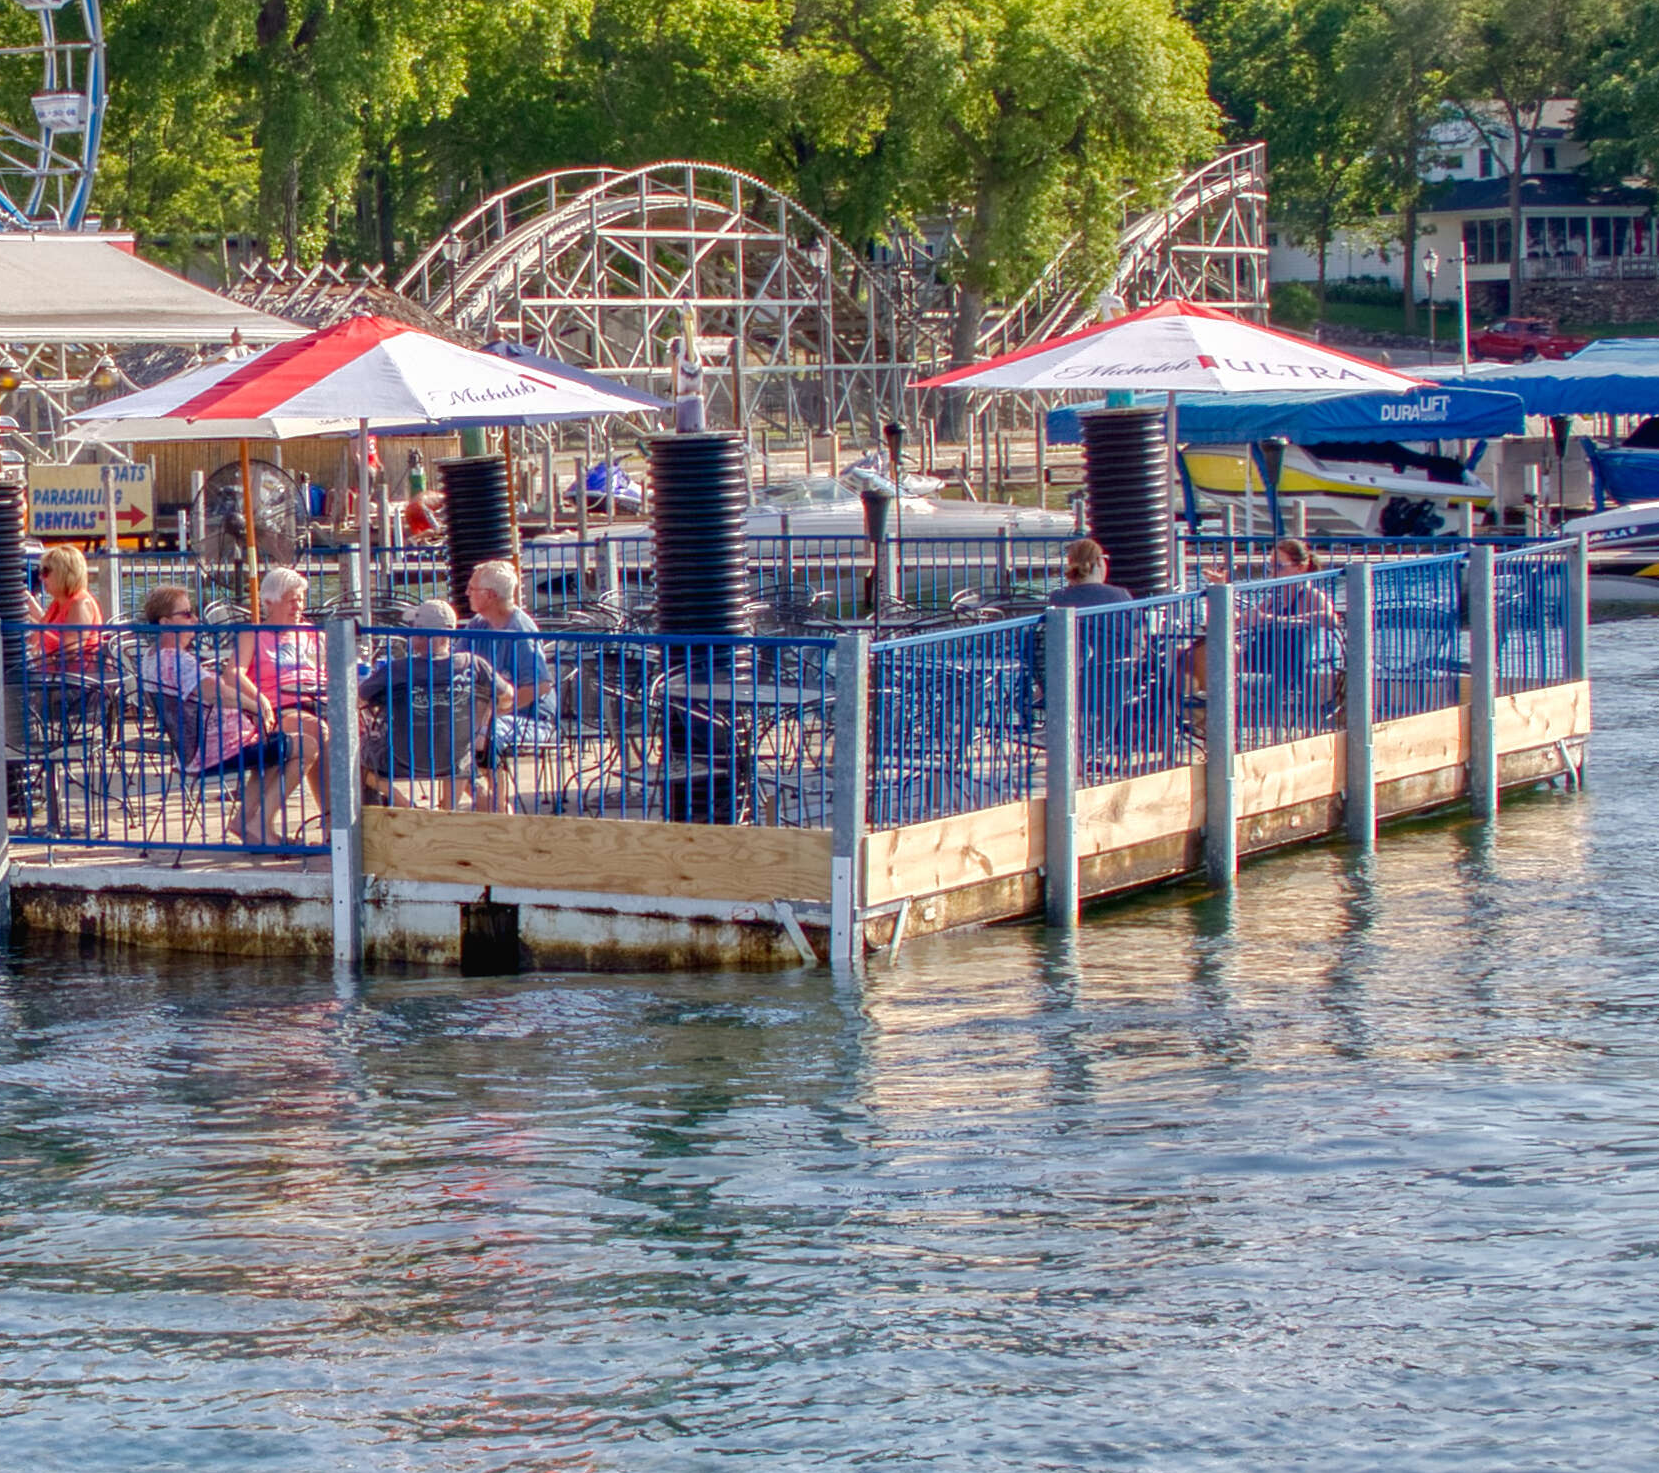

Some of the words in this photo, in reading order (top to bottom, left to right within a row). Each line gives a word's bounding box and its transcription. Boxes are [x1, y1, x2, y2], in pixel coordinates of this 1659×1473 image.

[1055, 357, 1191, 380] Michelob
[1224, 357, 1369, 382] ULTRA
[446, 379, 538, 406] Michelob
[1381, 404, 1421, 422] DURA
[1420, 394, 1451, 412] LIFT
[33, 488, 123, 506] PARASAILIG
[34, 511, 97, 531] RENTALS
